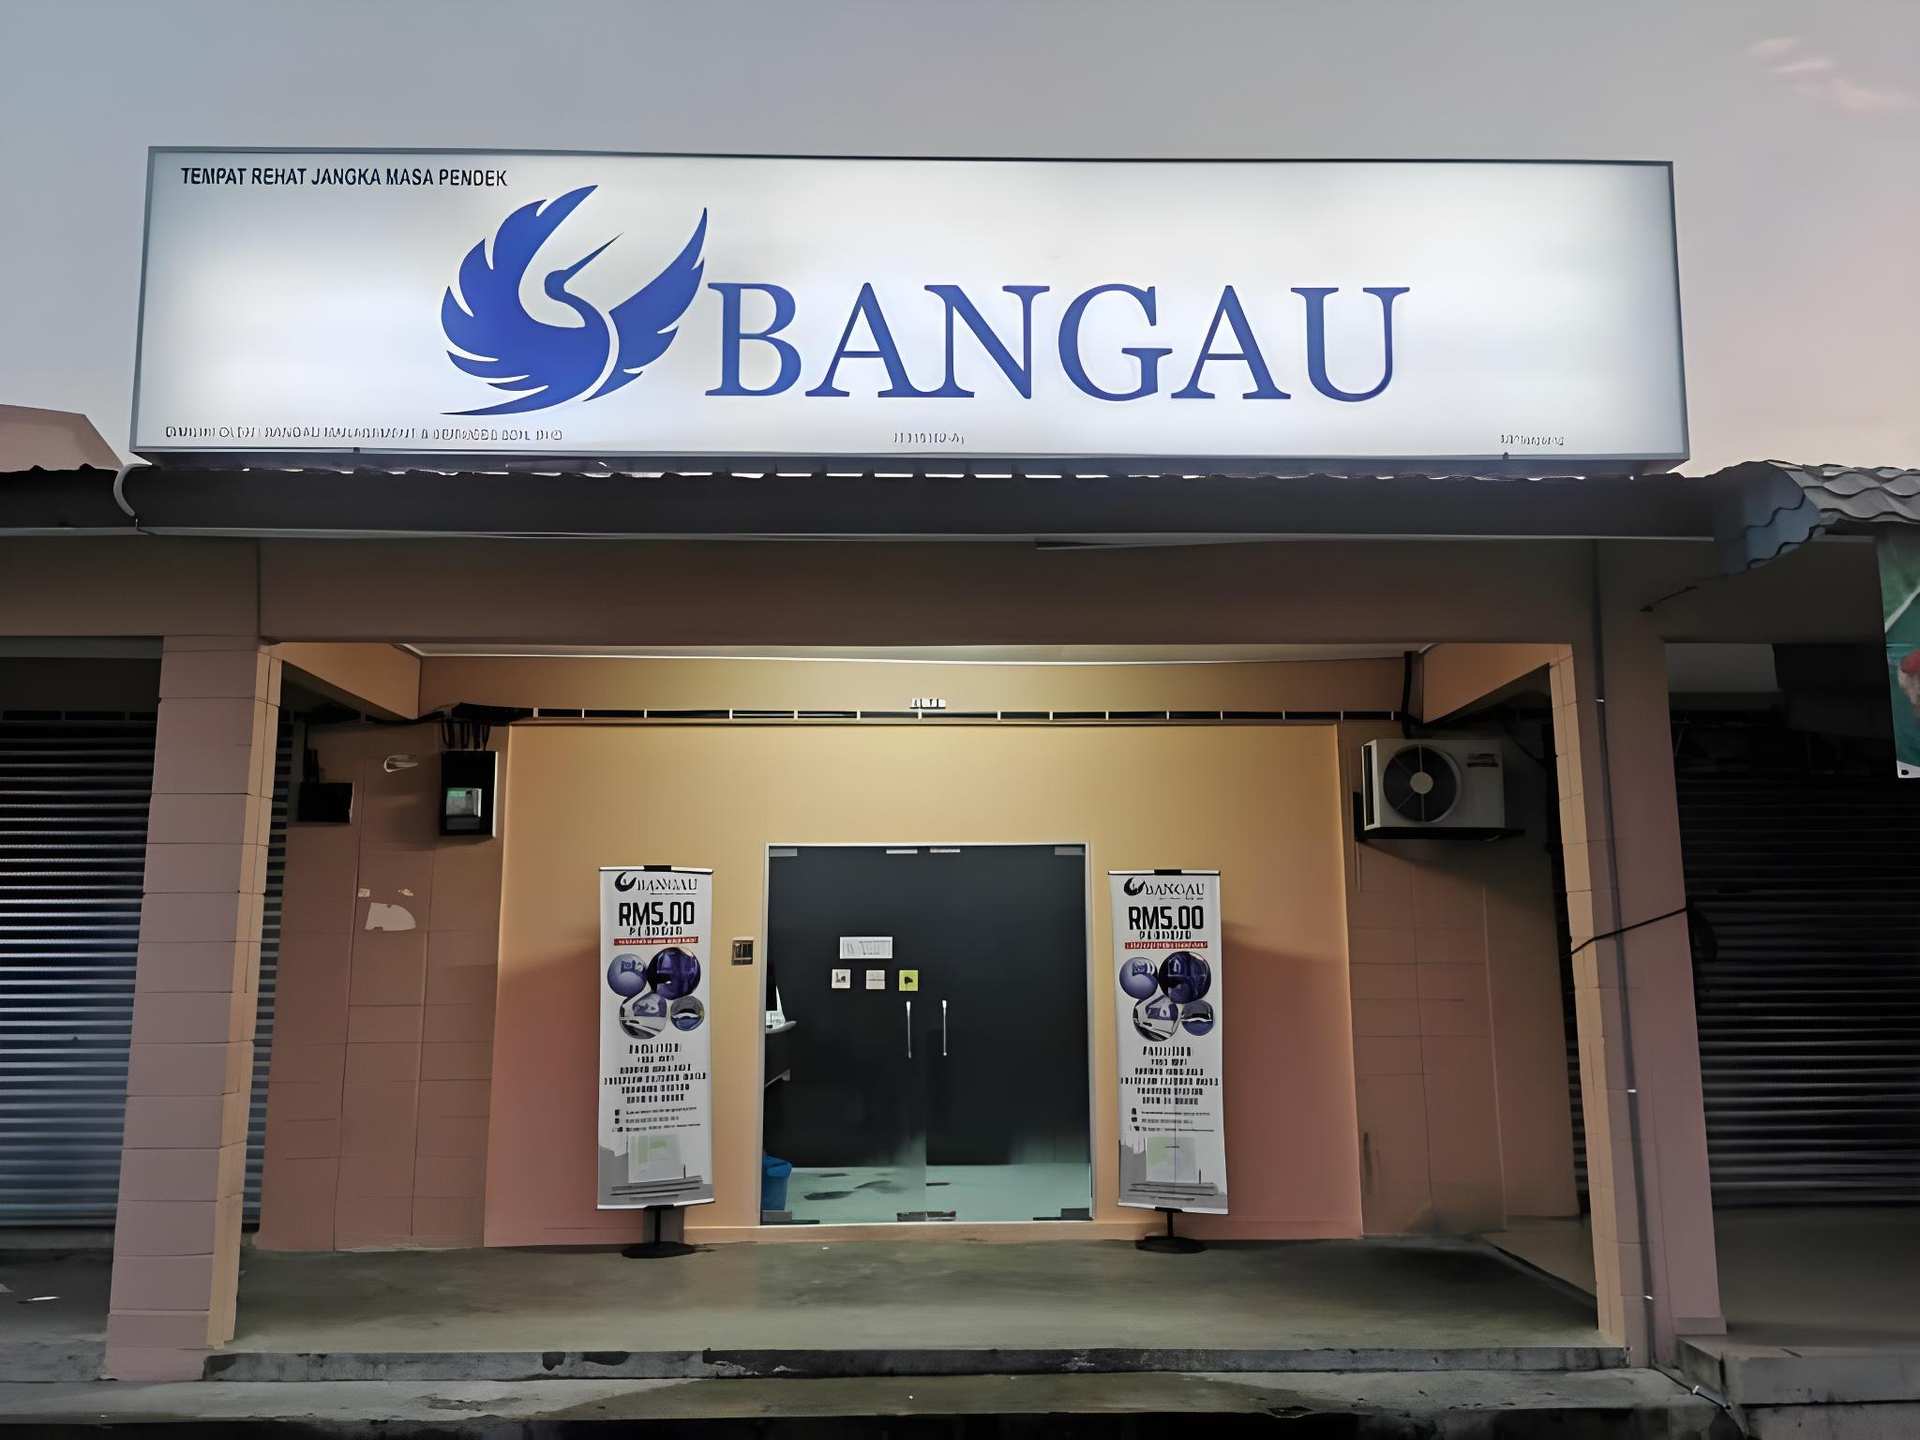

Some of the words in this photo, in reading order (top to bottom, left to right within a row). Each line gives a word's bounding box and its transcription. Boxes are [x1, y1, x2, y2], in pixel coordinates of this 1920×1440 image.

[180, 167, 247, 186] TEMPAT
[251, 167, 308, 186] REHAT
[311, 167, 382, 186] JANGKA
[385, 168, 434, 186] MASA
[439, 169, 508, 187] PENDEK
[704, 281, 1411, 403] BANGAU
[618, 901, 695, 928] RM5.00
[1128, 905, 1204, 931] RM5.00
